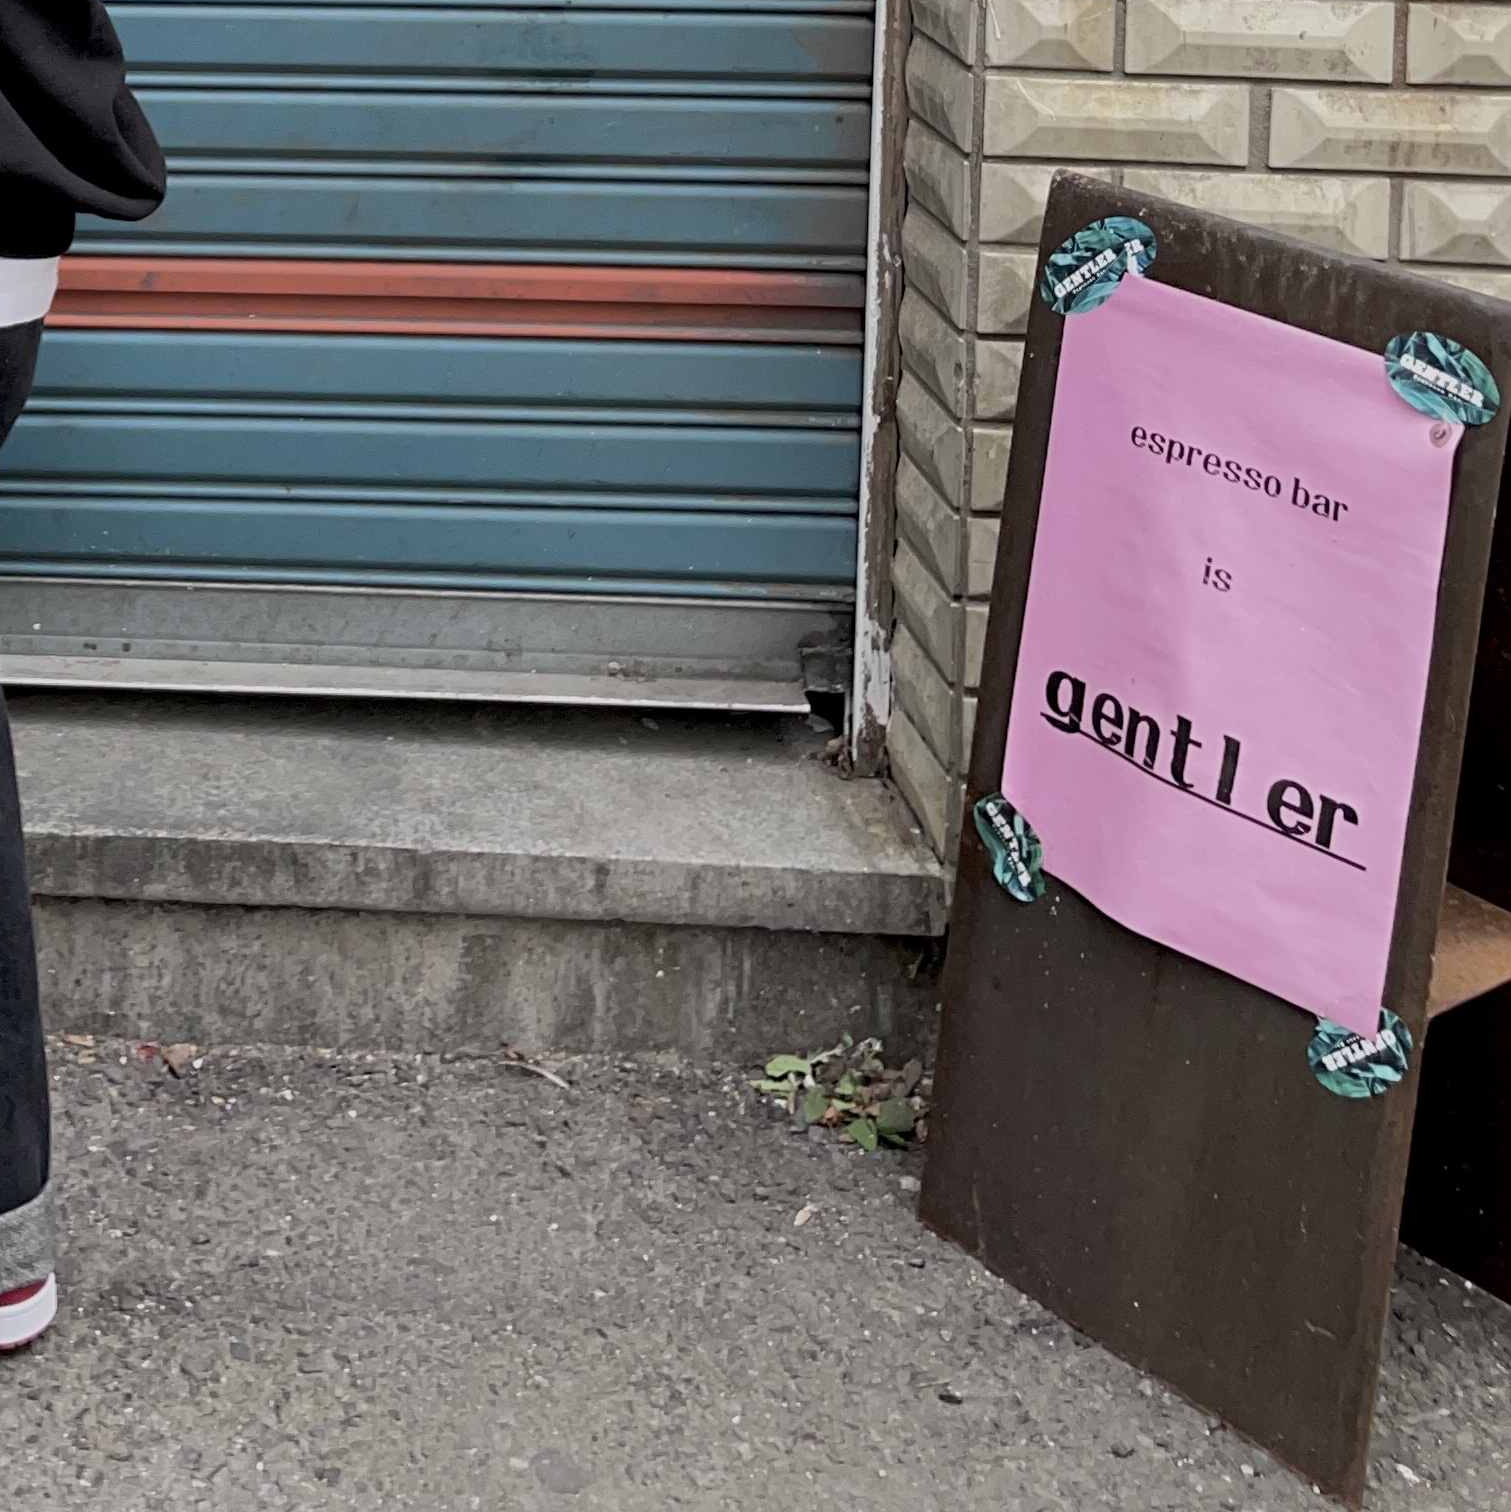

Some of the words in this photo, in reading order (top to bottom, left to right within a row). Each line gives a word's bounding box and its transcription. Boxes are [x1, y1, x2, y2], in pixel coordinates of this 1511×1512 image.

[1054, 248, 1117, 298] GENTLER
[1399, 353, 1484, 408] GENTLER
[1130, 425, 1282, 498] espresso
[1291, 476, 1349, 522] bar
[1202, 556, 1233, 592] is
